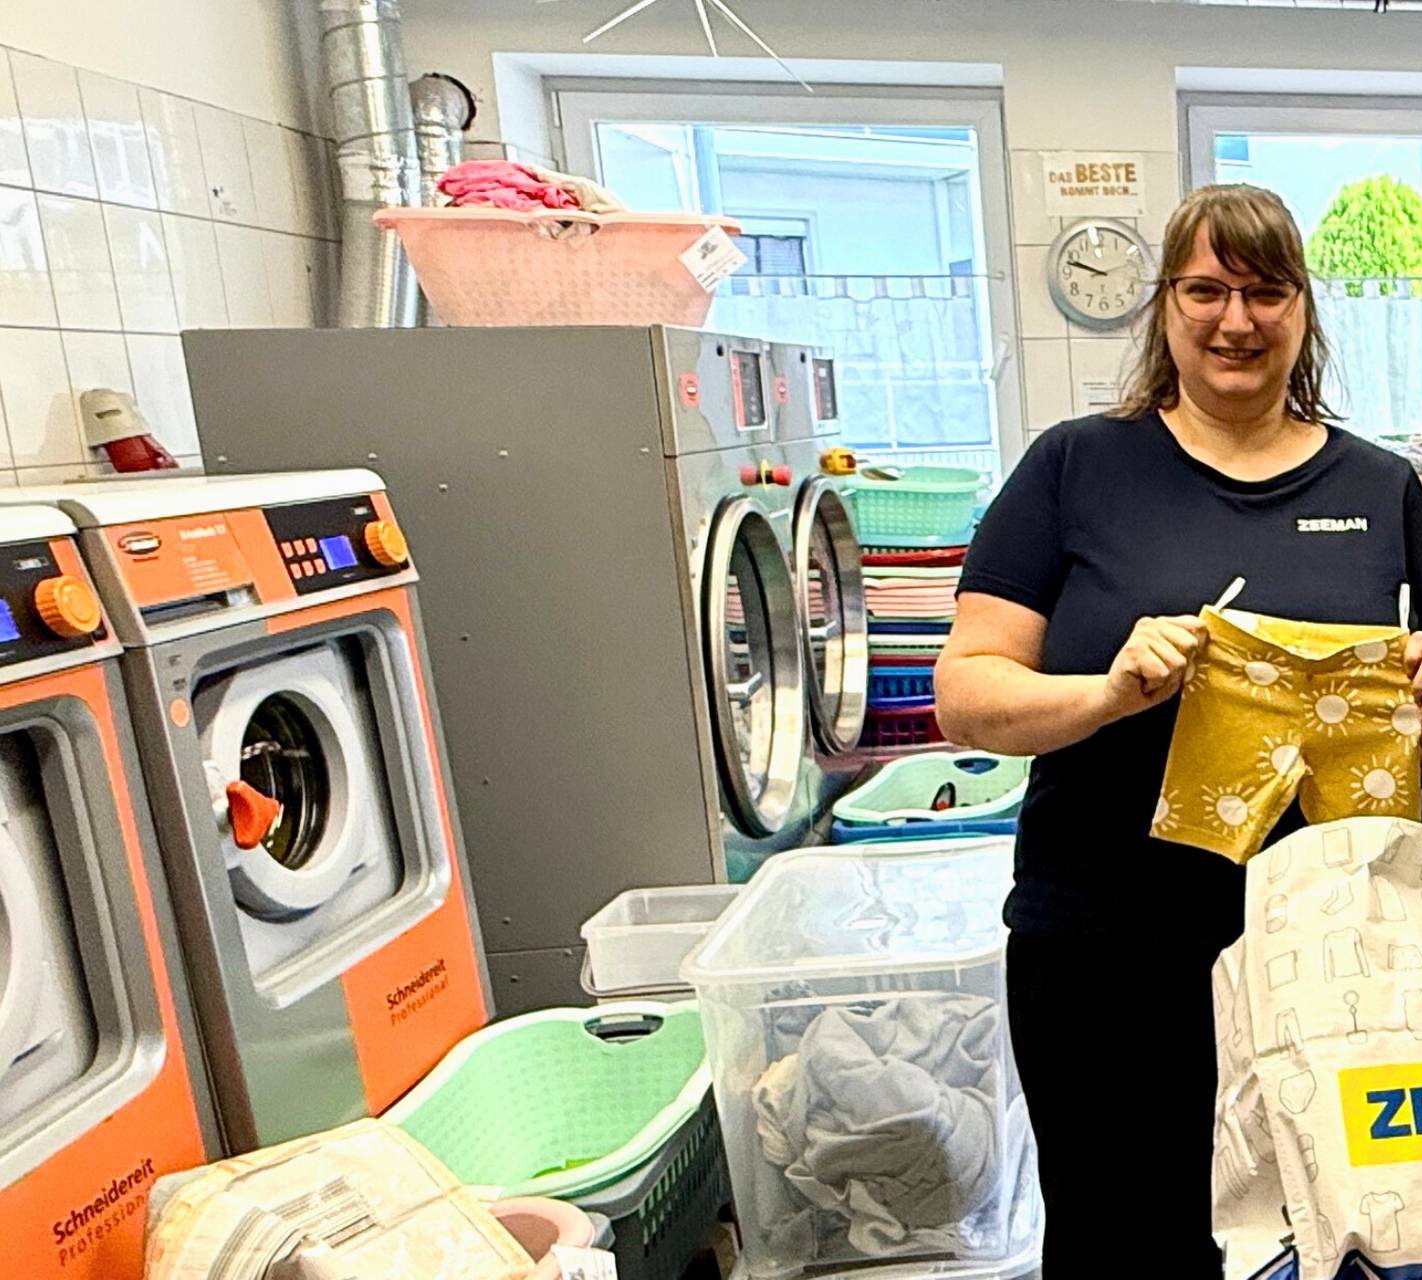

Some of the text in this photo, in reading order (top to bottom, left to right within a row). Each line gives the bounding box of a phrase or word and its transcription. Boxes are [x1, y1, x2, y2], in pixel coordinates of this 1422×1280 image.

[1049, 162, 1137, 183] DAS BESTE
[1062, 264, 1073, 281] 9
[1069, 281, 1080, 297] 8
[1126, 283, 1136, 297] 4
[1085, 293, 1094, 308] 7
[1099, 296, 1110, 311] 6
[1115, 294, 1125, 308] 5
[1297, 517, 1368, 532] ZEEMAN
[386, 958, 447, 1010] Schneidereit
[53, 1158, 155, 1245] Schneidereit
[59, 1194, 146, 1266] Profession
